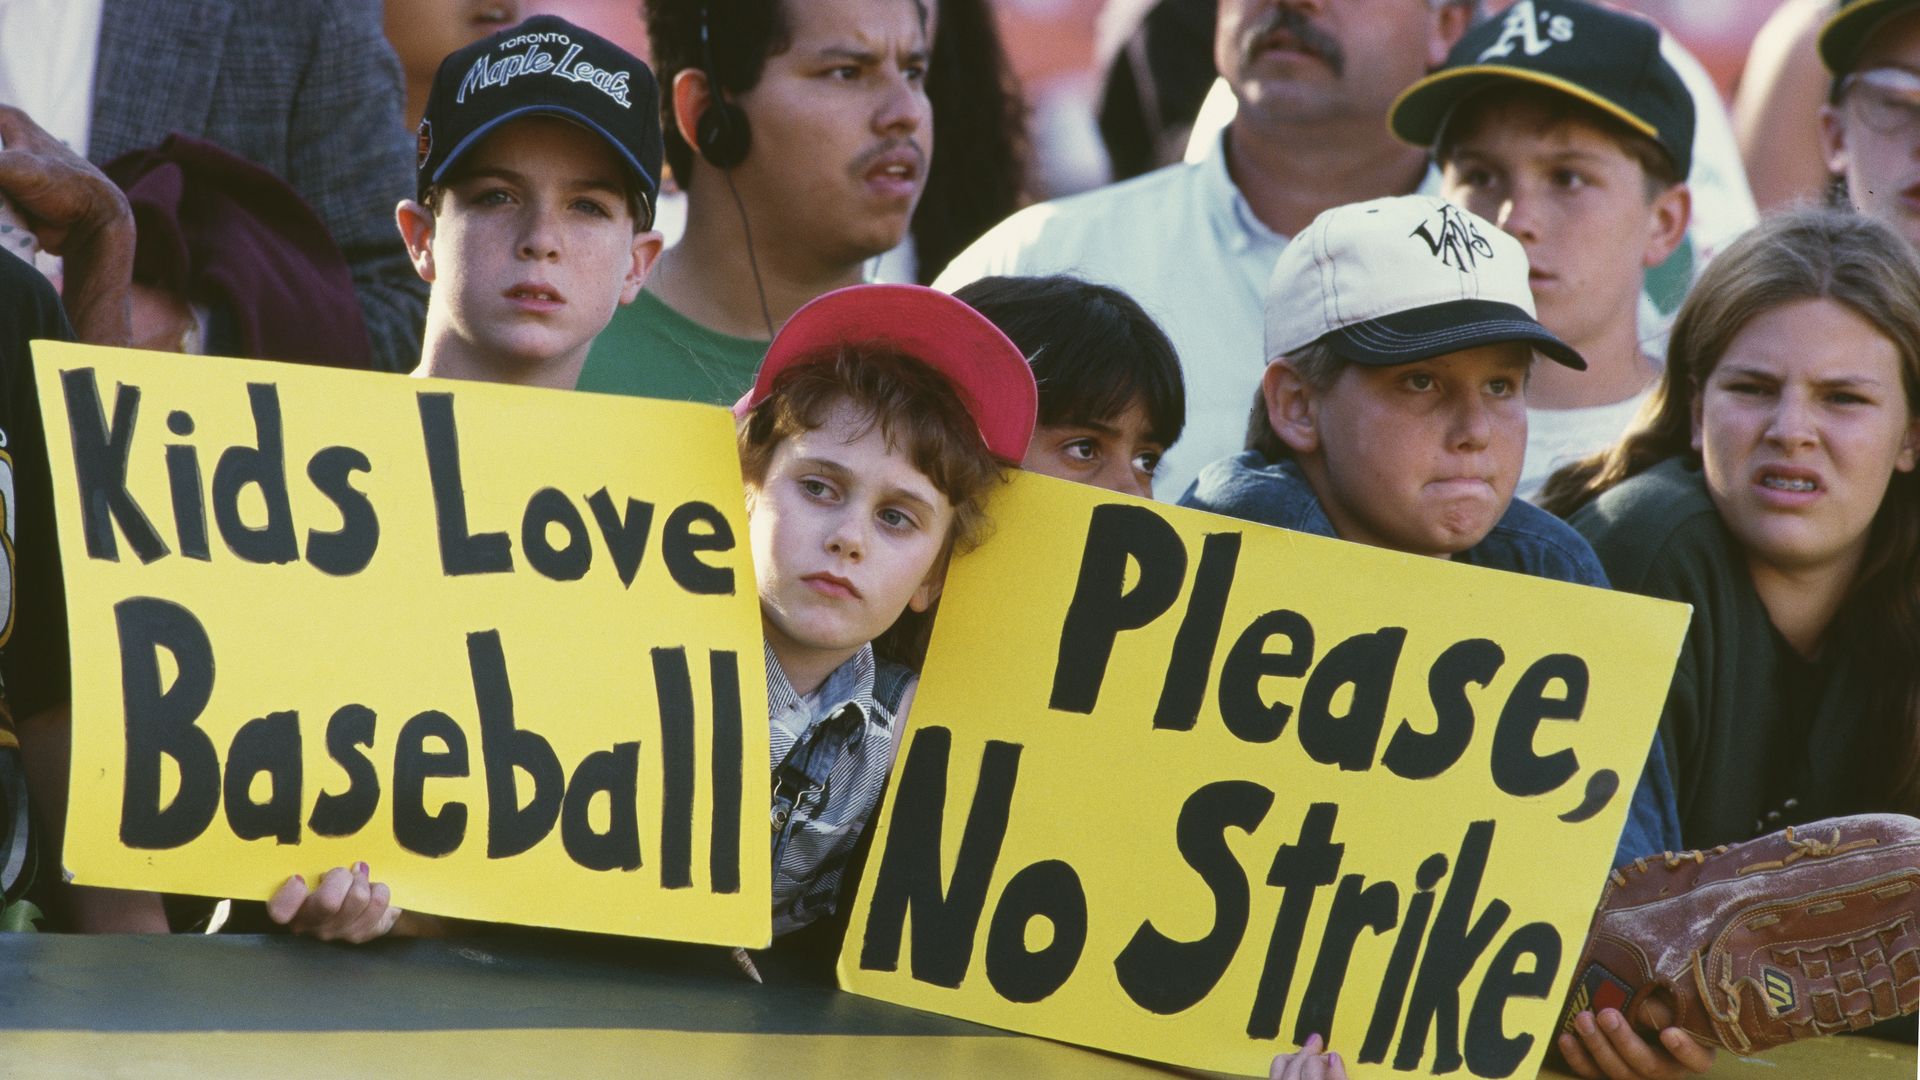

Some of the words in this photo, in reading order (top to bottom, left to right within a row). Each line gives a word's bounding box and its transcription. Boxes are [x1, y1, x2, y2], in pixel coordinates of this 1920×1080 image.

[456, 44, 554, 104] Maple
[552, 43, 632, 109] Leafs
[499, 33, 570, 51] TORONTO
[1477, 0, 1573, 63] A's
[60, 367, 379, 577] Kids
[417, 391, 736, 596] Love
[114, 596, 743, 894] Baseball
[1048, 503, 1620, 823] Please,
[860, 726, 1088, 1004] No
[1114, 780, 1563, 1079] Strike
